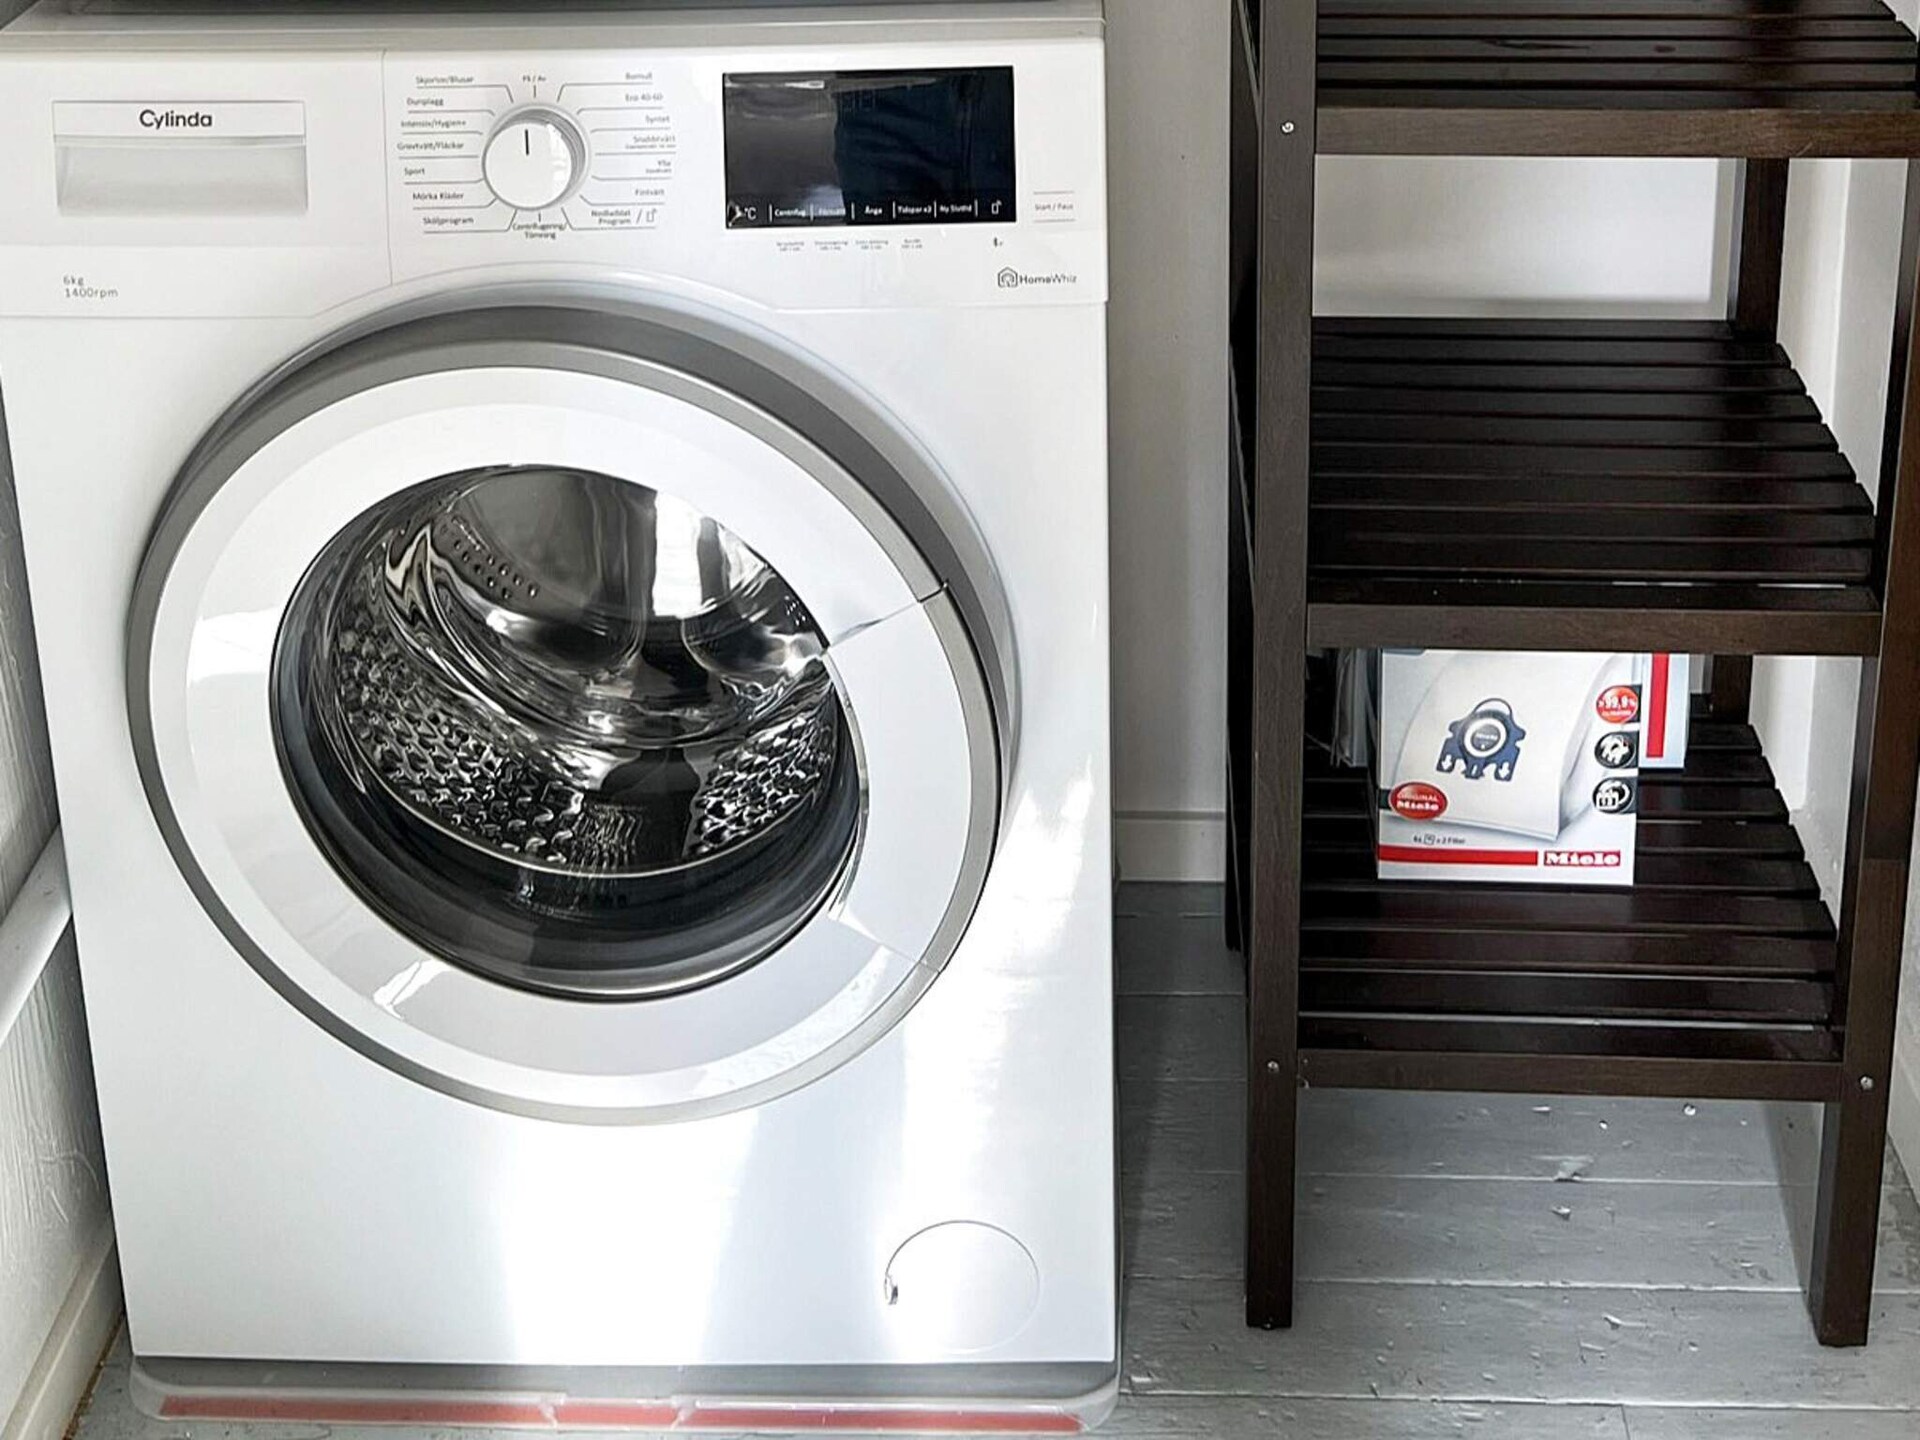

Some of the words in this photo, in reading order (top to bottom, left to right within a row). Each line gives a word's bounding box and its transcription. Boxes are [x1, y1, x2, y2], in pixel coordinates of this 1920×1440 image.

[139, 109, 213, 130] Cylinda
[404, 168, 425, 177] Sport
[413, 191, 437, 200] Mörka
[440, 191, 464, 200] Kläder
[1035, 203, 1051, 211] Start
[423, 217, 474, 226] Sköljprogram
[598, 218, 631, 226] Program
[63, 275, 85, 287] 6kg
[1019, 273, 1077, 284] HomeWhiz
[65, 288, 118, 299] 1400rpm
[1396, 792, 1439, 802] ORIGINAL
[1396, 800, 1440, 812] Miele
[1544, 852, 1620, 867] Miele
